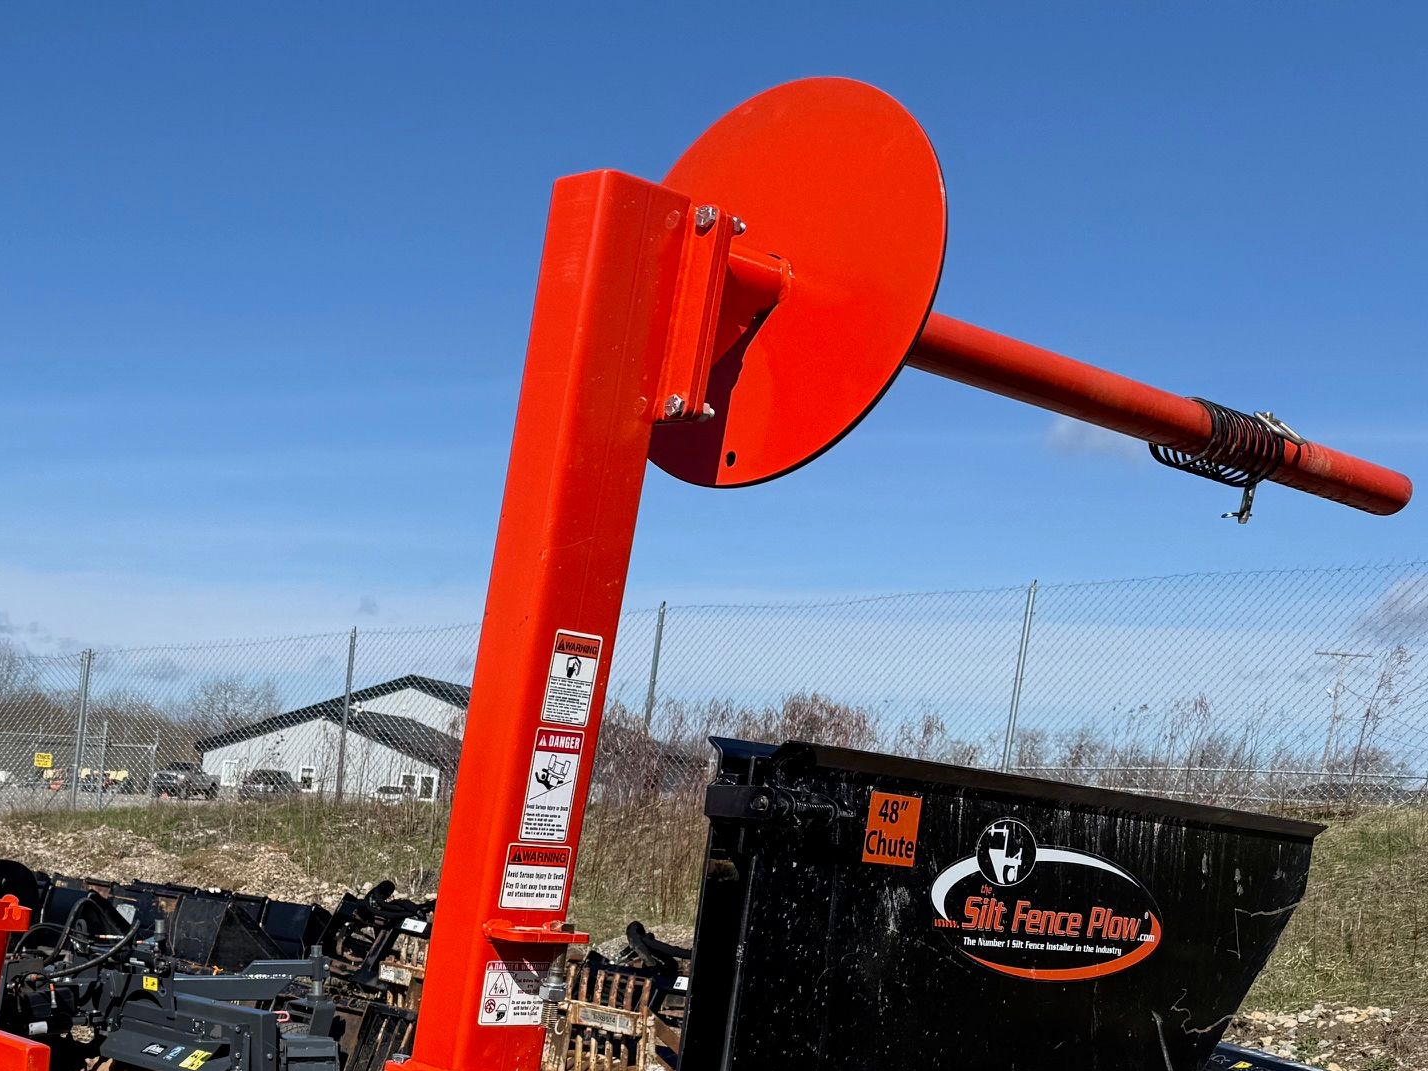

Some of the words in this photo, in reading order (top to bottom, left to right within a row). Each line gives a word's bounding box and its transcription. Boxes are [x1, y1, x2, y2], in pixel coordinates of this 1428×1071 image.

[565, 641, 598, 655] WARNING
[549, 735, 580, 750] DANGER
[865, 829, 915, 859] Chute
[523, 851, 566, 864] WARNING
[980, 883, 993, 895] the
[961, 896, 1008, 933] Silt
[1011, 900, 1083, 938] Fence
[1086, 906, 1142, 941] Plow
[963, 936, 977, 946] The
[977, 937, 1006, 948] Number
[1011, 939, 1024, 949] Silt
[1024, 940, 1045, 950] Fence
[1045, 941, 1075, 952] Installer
[1075, 943, 1082, 952] in
[1082, 944, 1095, 953] the
[1095, 944, 1123, 957] Industry
